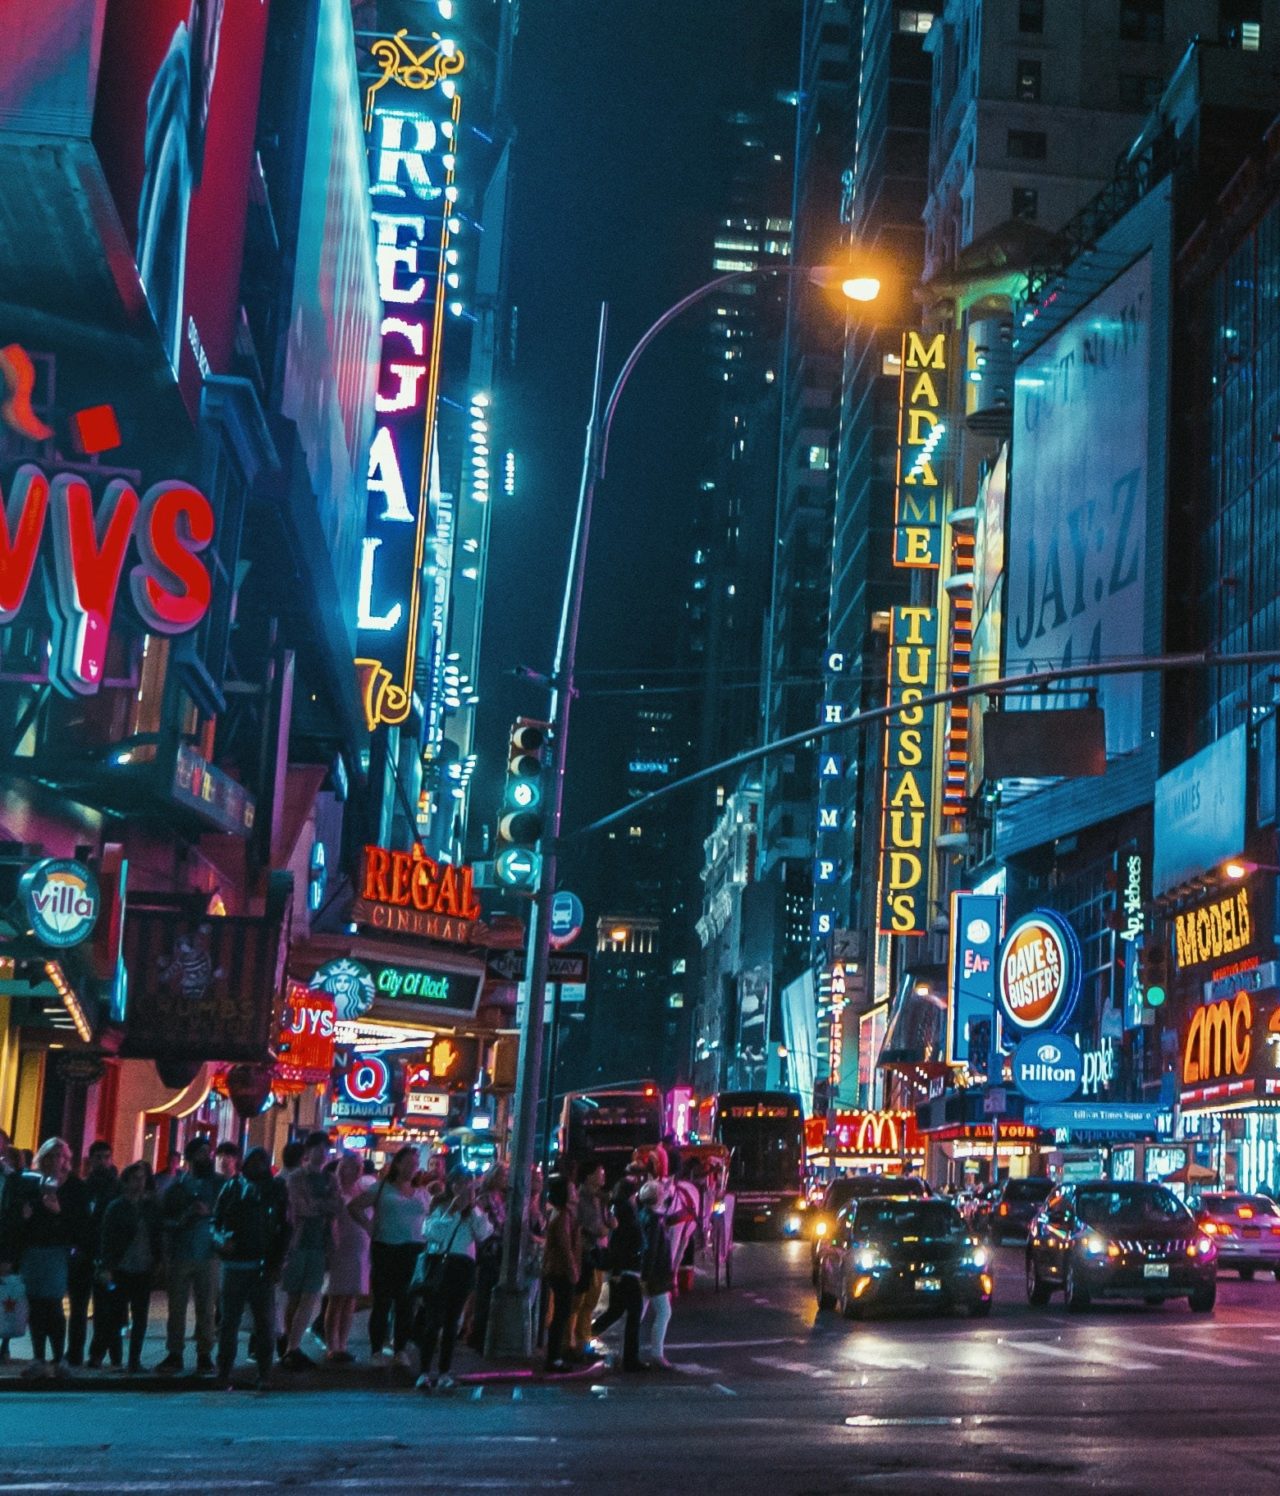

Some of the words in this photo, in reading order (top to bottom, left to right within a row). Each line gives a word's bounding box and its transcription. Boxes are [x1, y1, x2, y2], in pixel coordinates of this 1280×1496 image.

[355, 108, 442, 631] REGAL
[902, 331, 946, 566] MADAME
[817, 653, 844, 934] CHAMPS
[31, 886, 94, 919] villa
[362, 844, 481, 921] REGAL
[372, 907, 468, 942] CINEMAS
[1007, 940, 1046, 983] DAVE
[1044, 937, 1058, 965] &
[377, 969, 401, 998] City
[402, 971, 422, 995] Of
[419, 975, 449, 999] Rock
[1008, 965, 1060, 1009] BUSTER'S
[1020, 1063, 1077, 1085] Hilton
[331, 1103, 395, 1117] RESTAURANT
